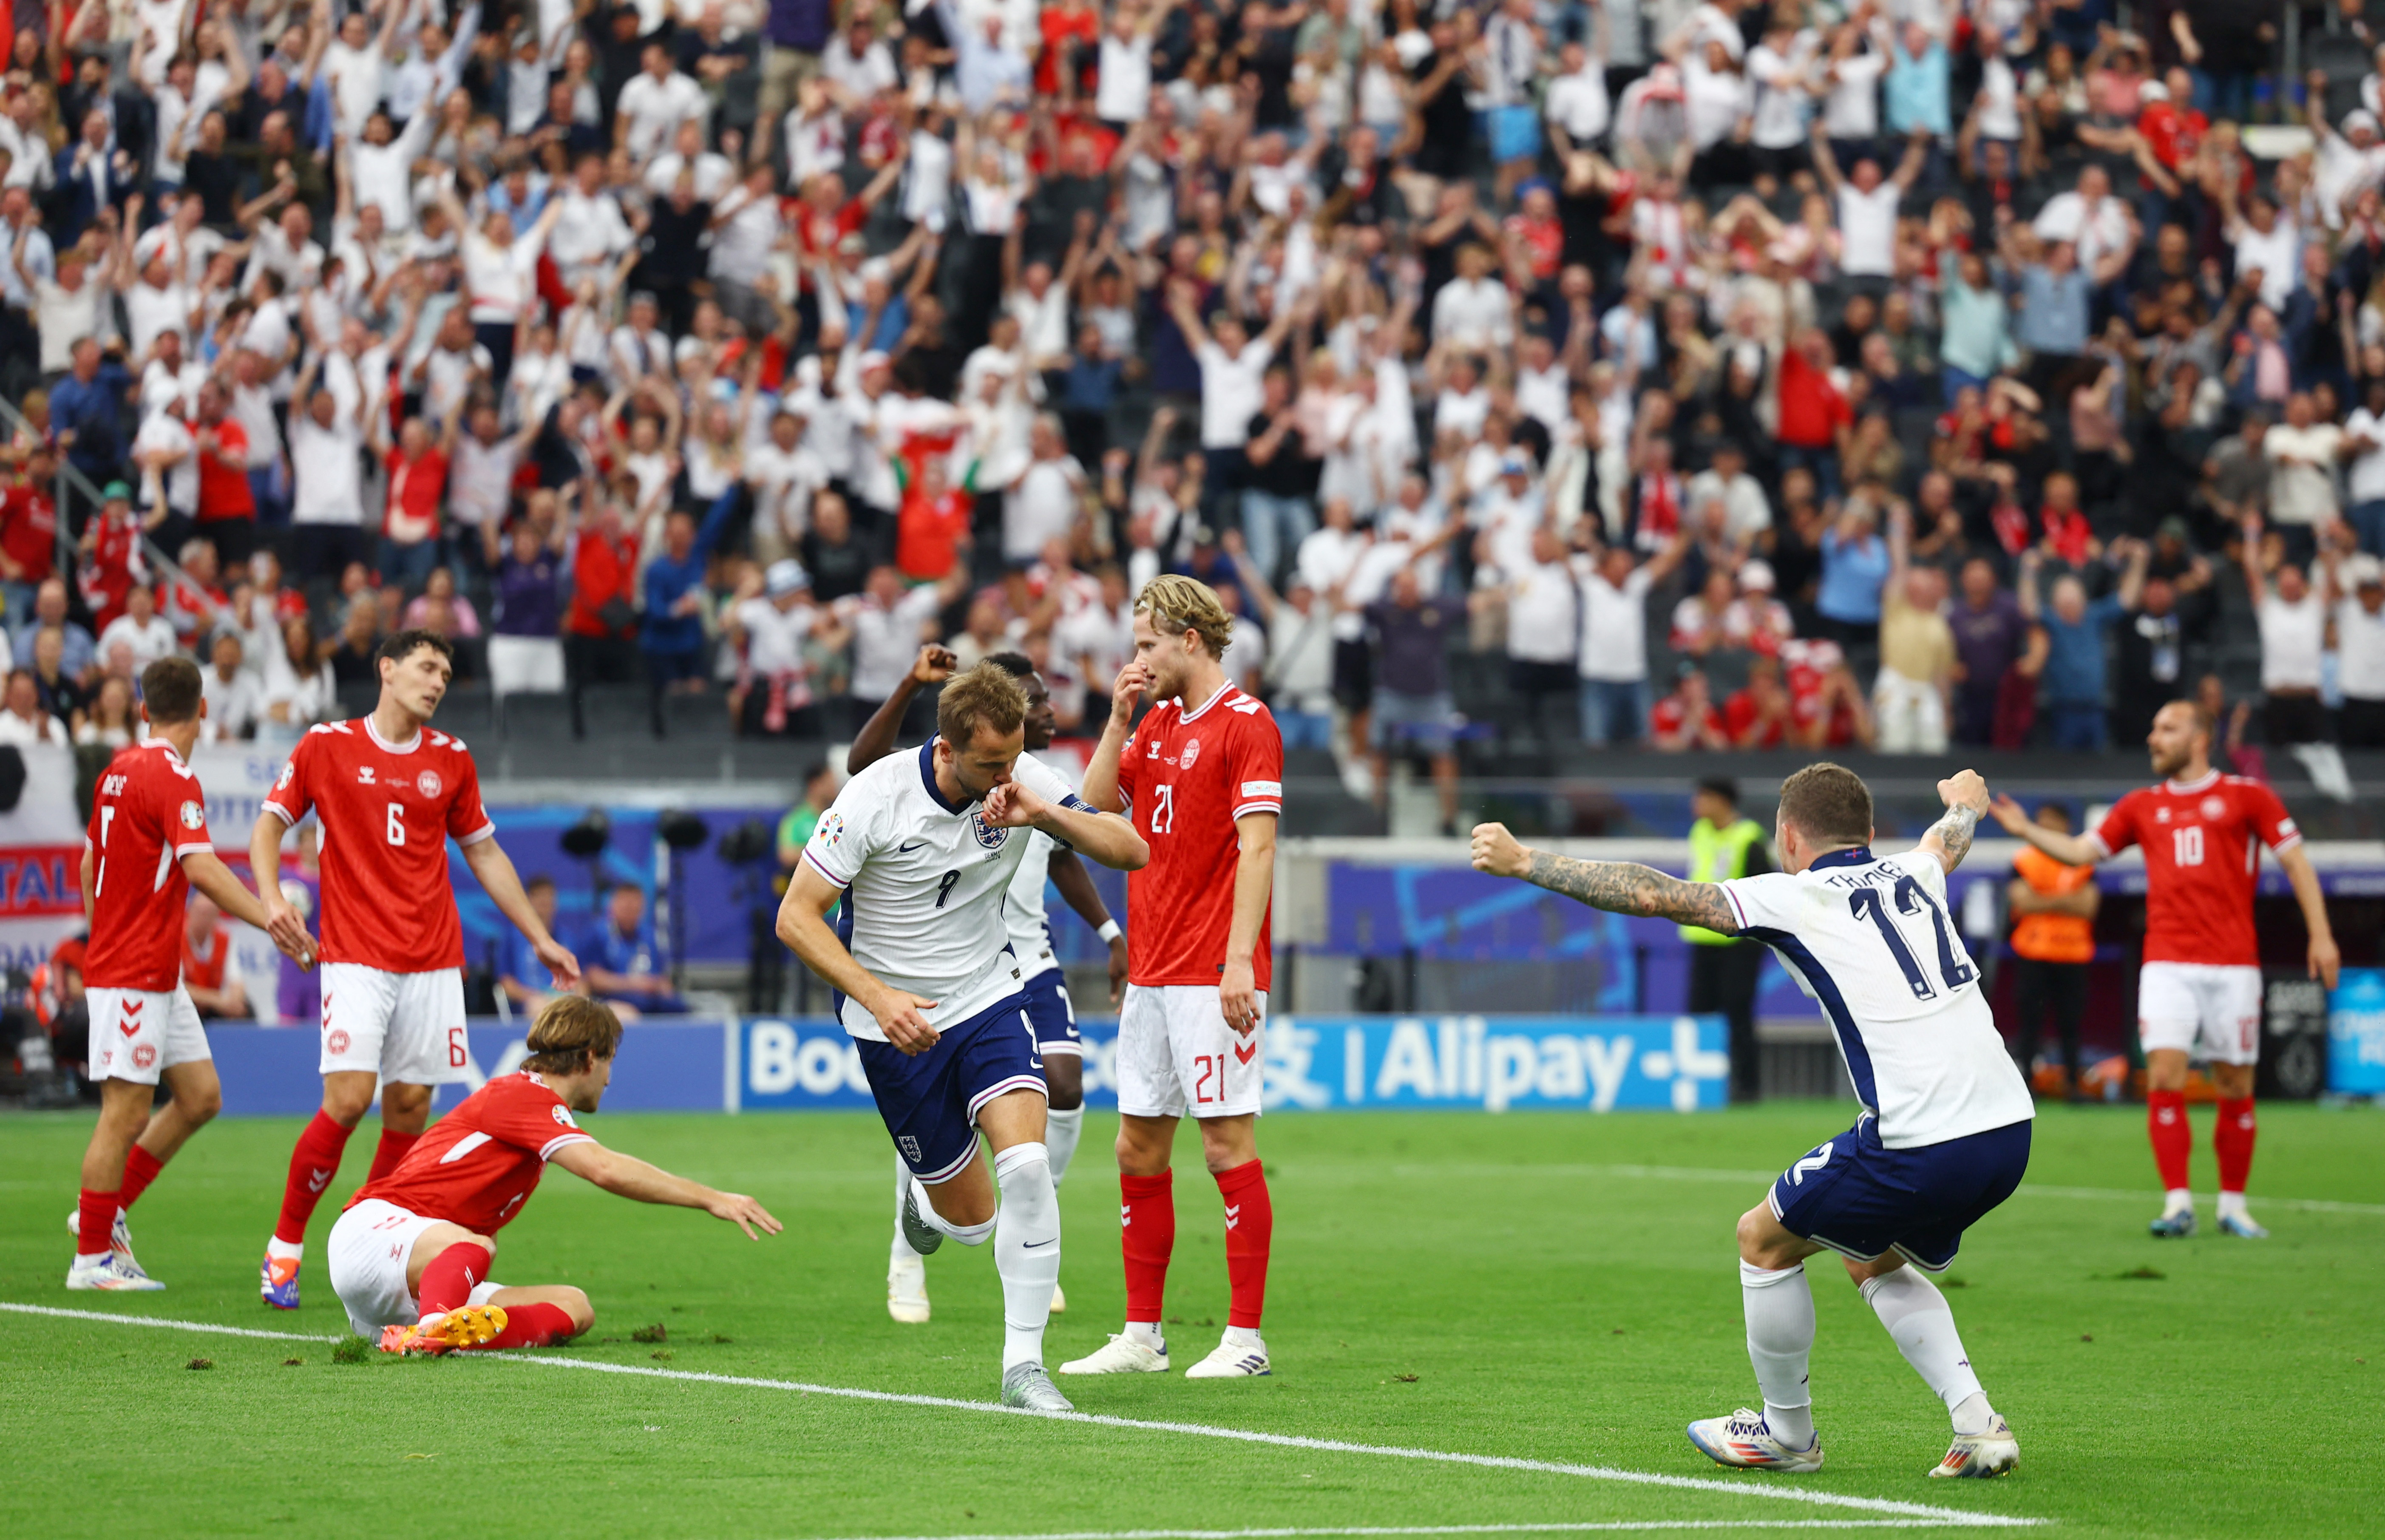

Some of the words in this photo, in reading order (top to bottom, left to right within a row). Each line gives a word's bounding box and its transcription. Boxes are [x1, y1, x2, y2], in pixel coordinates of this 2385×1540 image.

[387, 803, 405, 846] 6
[1151, 784, 1173, 834] 21
[2172, 826, 2204, 867] 10
[936, 870, 961, 908] 9
[1849, 874, 1976, 1001] 12
[1055, 984, 1076, 1024] 7
[449, 1028, 465, 1066] 6
[1020, 1009, 1038, 1055] 9
[1195, 1054, 1224, 1103] 21
[1792, 1140, 1834, 1186] 2
